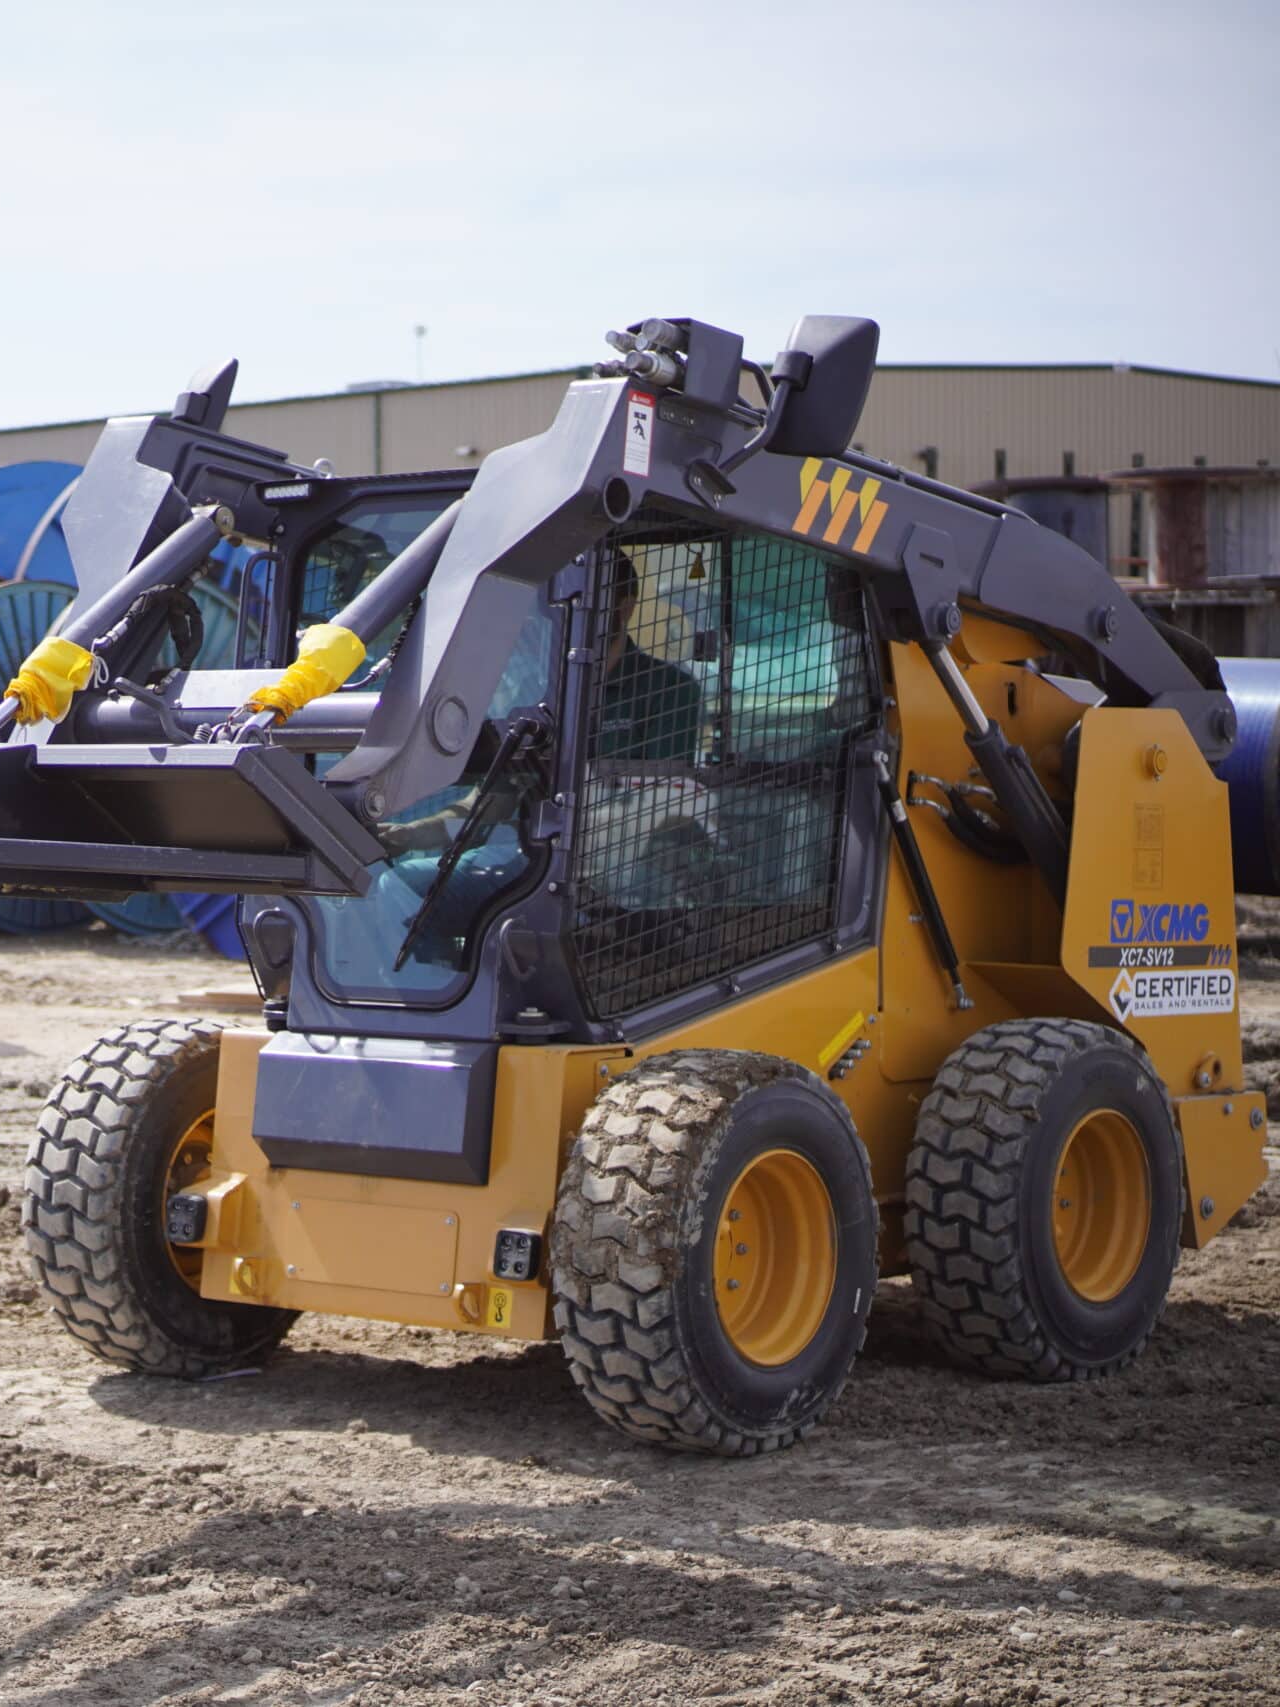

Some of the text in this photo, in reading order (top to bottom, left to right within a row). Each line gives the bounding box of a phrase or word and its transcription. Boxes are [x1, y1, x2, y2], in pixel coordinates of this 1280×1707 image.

[1134, 903, 1210, 942] XCMG
[1119, 947, 1175, 967] XC7-SV12
[1134, 976, 1232, 998] CERTIFIED
[1134, 998, 1231, 1010] SALES AND RENTALS
